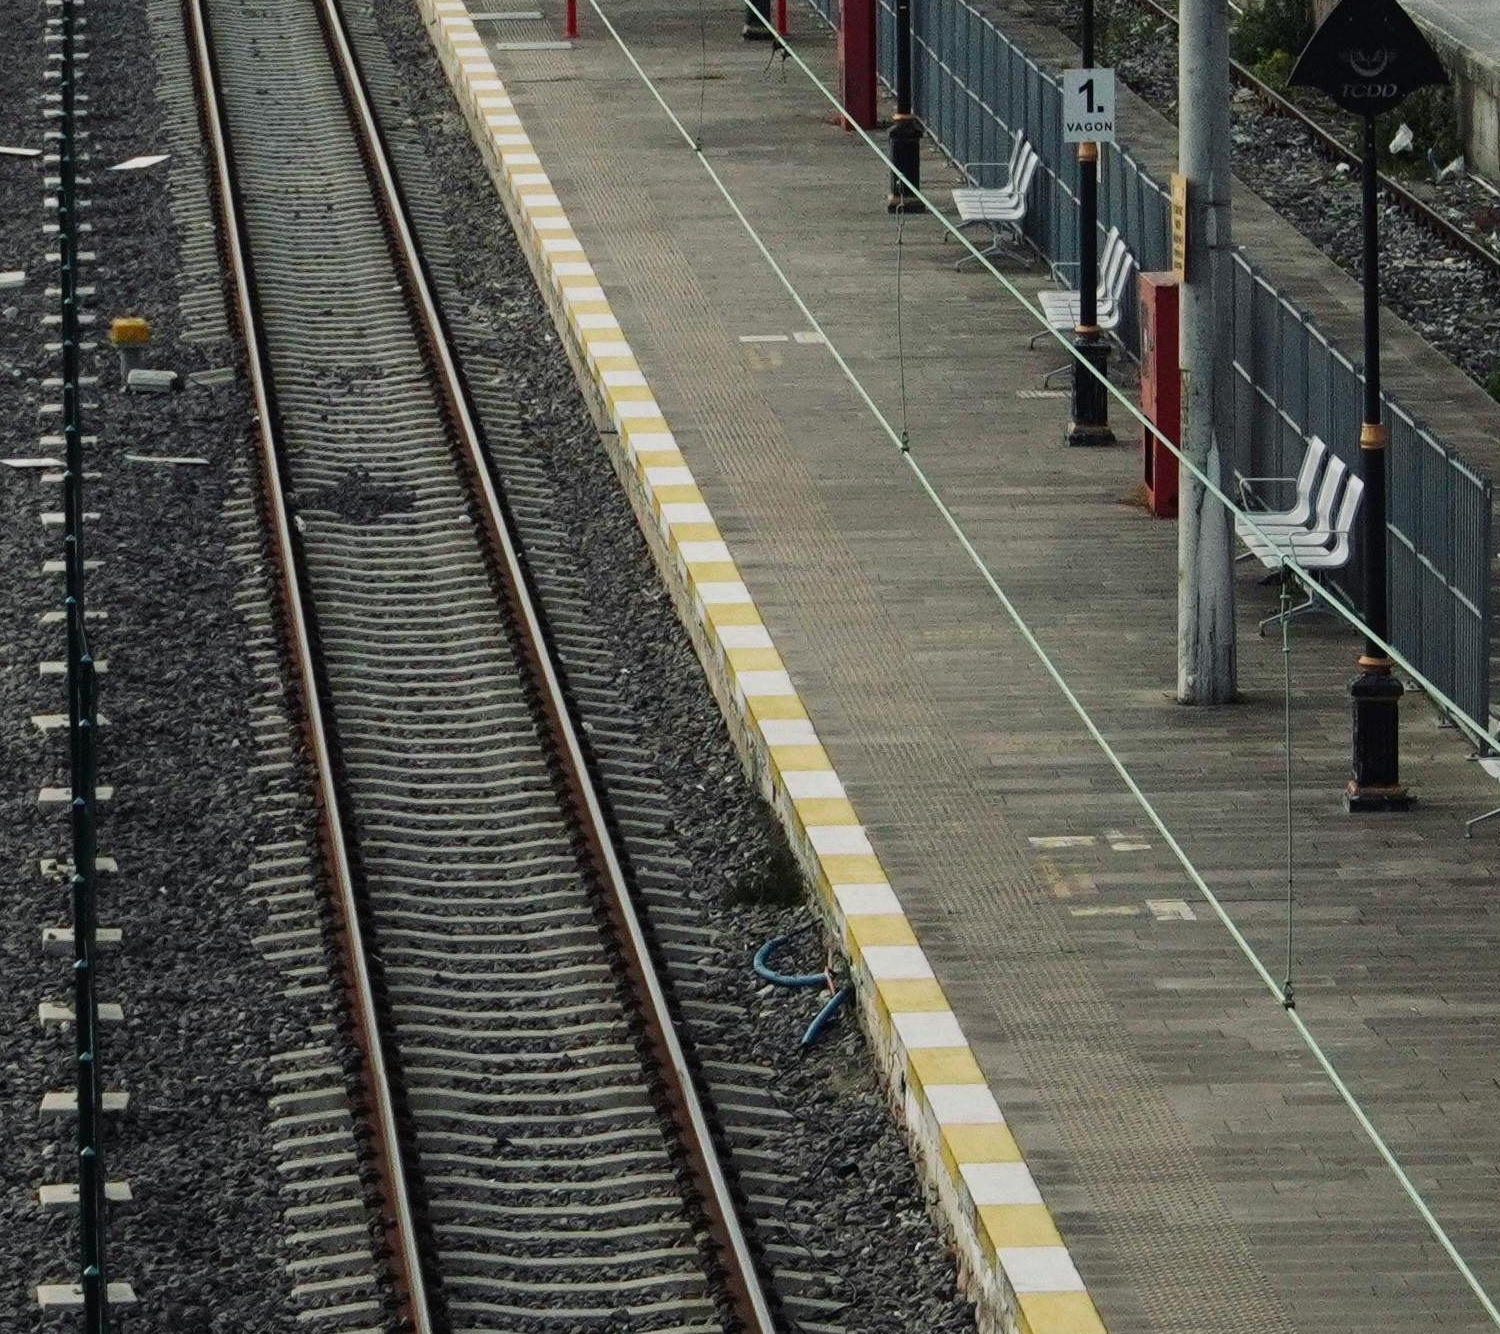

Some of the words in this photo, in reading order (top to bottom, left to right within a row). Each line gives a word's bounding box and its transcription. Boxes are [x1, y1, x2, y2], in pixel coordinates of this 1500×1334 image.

[1078, 79, 1104, 113] 1.
[1342, 83, 1398, 98] TCDD
[1067, 122, 1113, 133] VAGON
